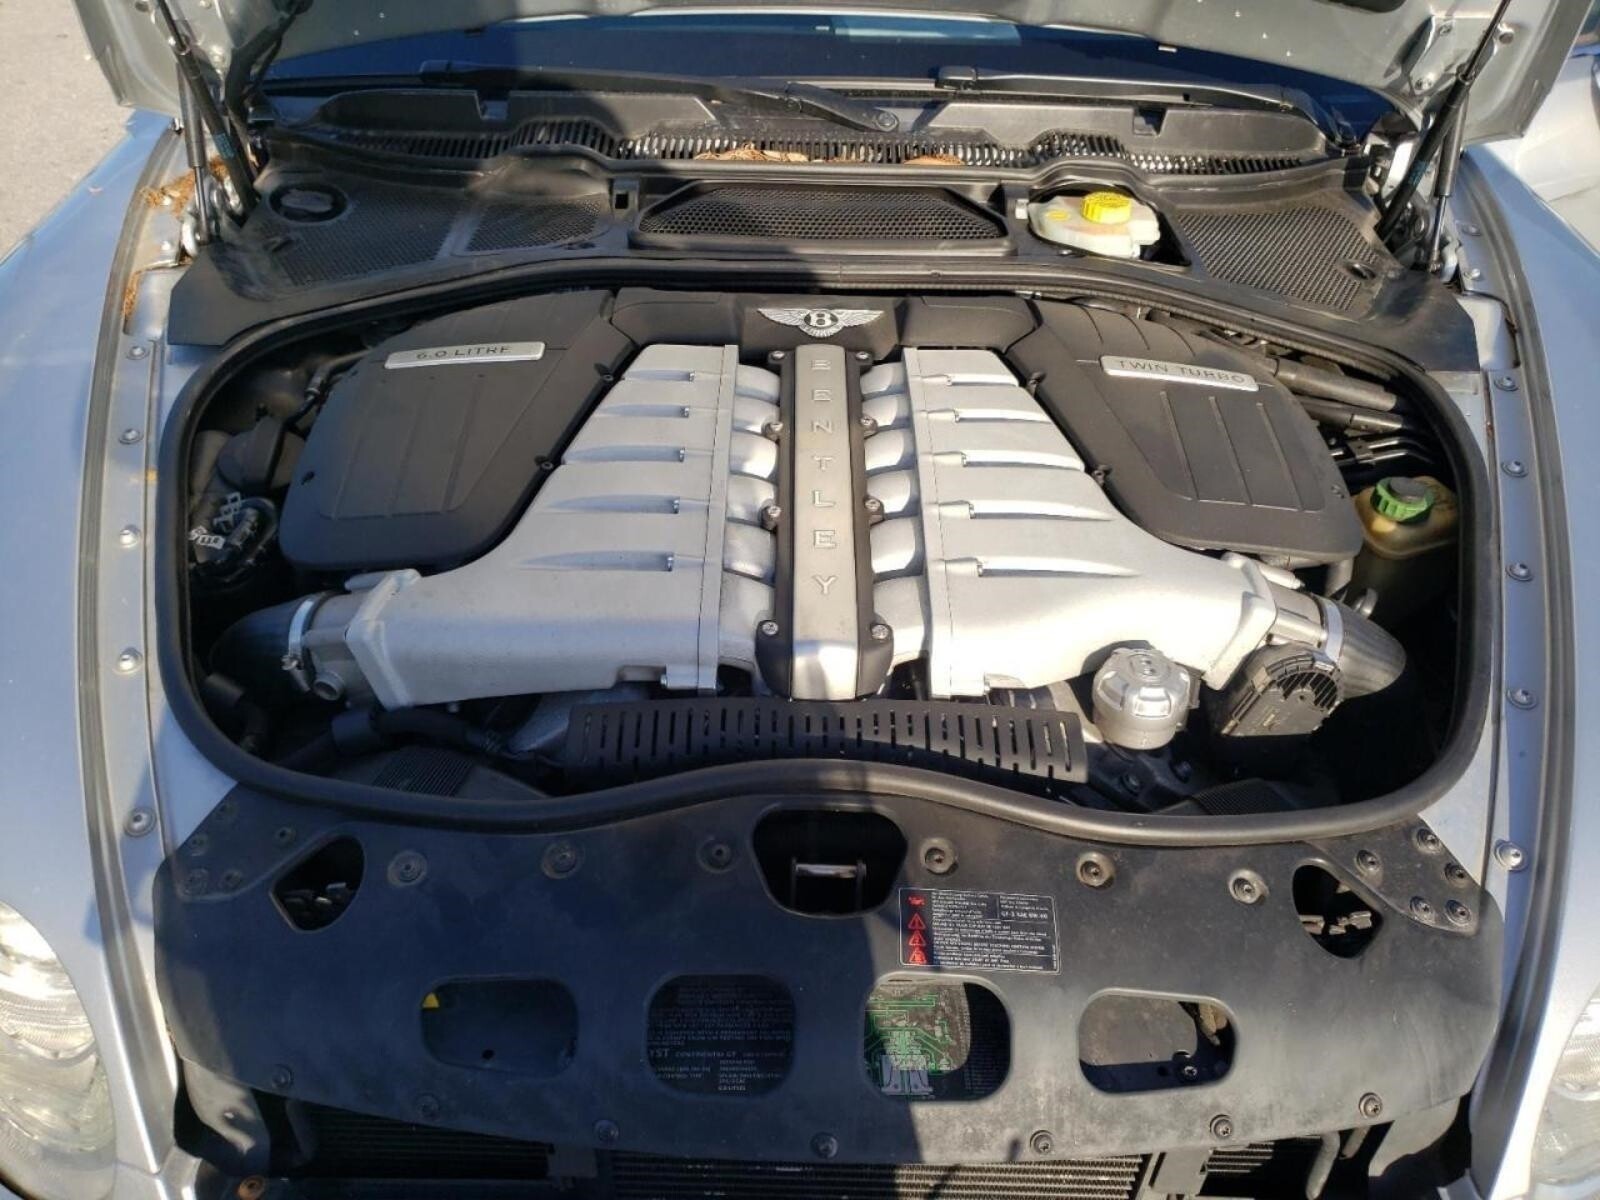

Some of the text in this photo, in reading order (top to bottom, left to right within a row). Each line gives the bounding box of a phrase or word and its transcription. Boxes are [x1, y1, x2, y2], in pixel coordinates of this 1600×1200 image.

[416, 346, 512, 360] 6.0 LITRE
[1119, 359, 1246, 384] TWIN TURBO
[811, 358, 838, 596] BENTLEY
